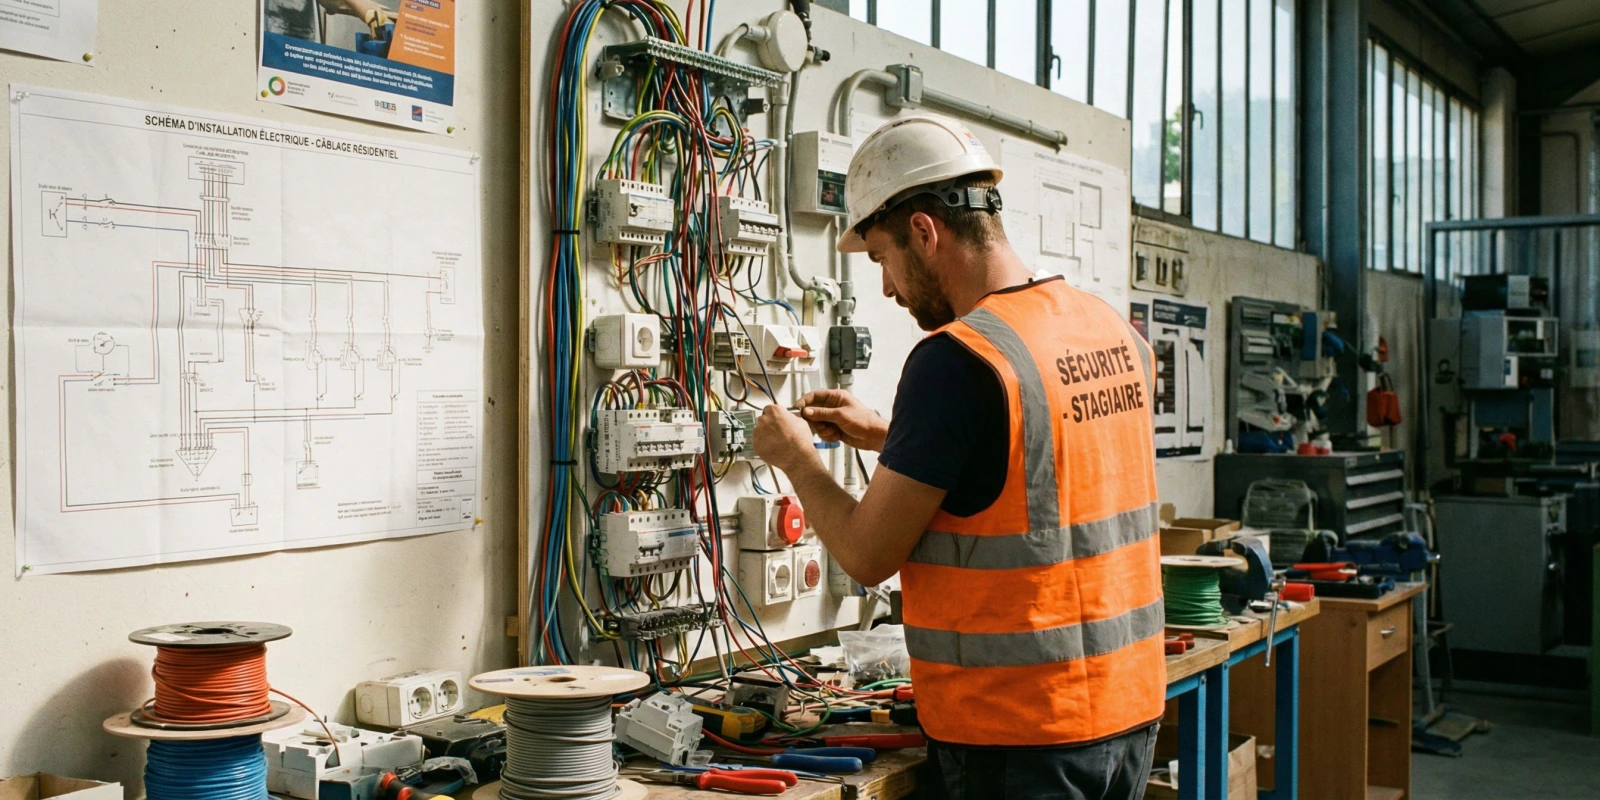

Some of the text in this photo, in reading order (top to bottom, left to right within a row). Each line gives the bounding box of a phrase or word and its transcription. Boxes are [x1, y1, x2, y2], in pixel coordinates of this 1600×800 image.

[145, 115, 186, 130] SCHÉMA
[188, 120, 258, 139] D'INSTALLATION
[260, 128, 309, 147] ÉLECTRIQUE
[315, 137, 352, 153] CÂBLAGE
[353, 144, 399, 160] RÉSIDENTIEL
[1056, 339, 1135, 386] SÉCURITÉ
[1071, 381, 1144, 424] STAGIAIRE
